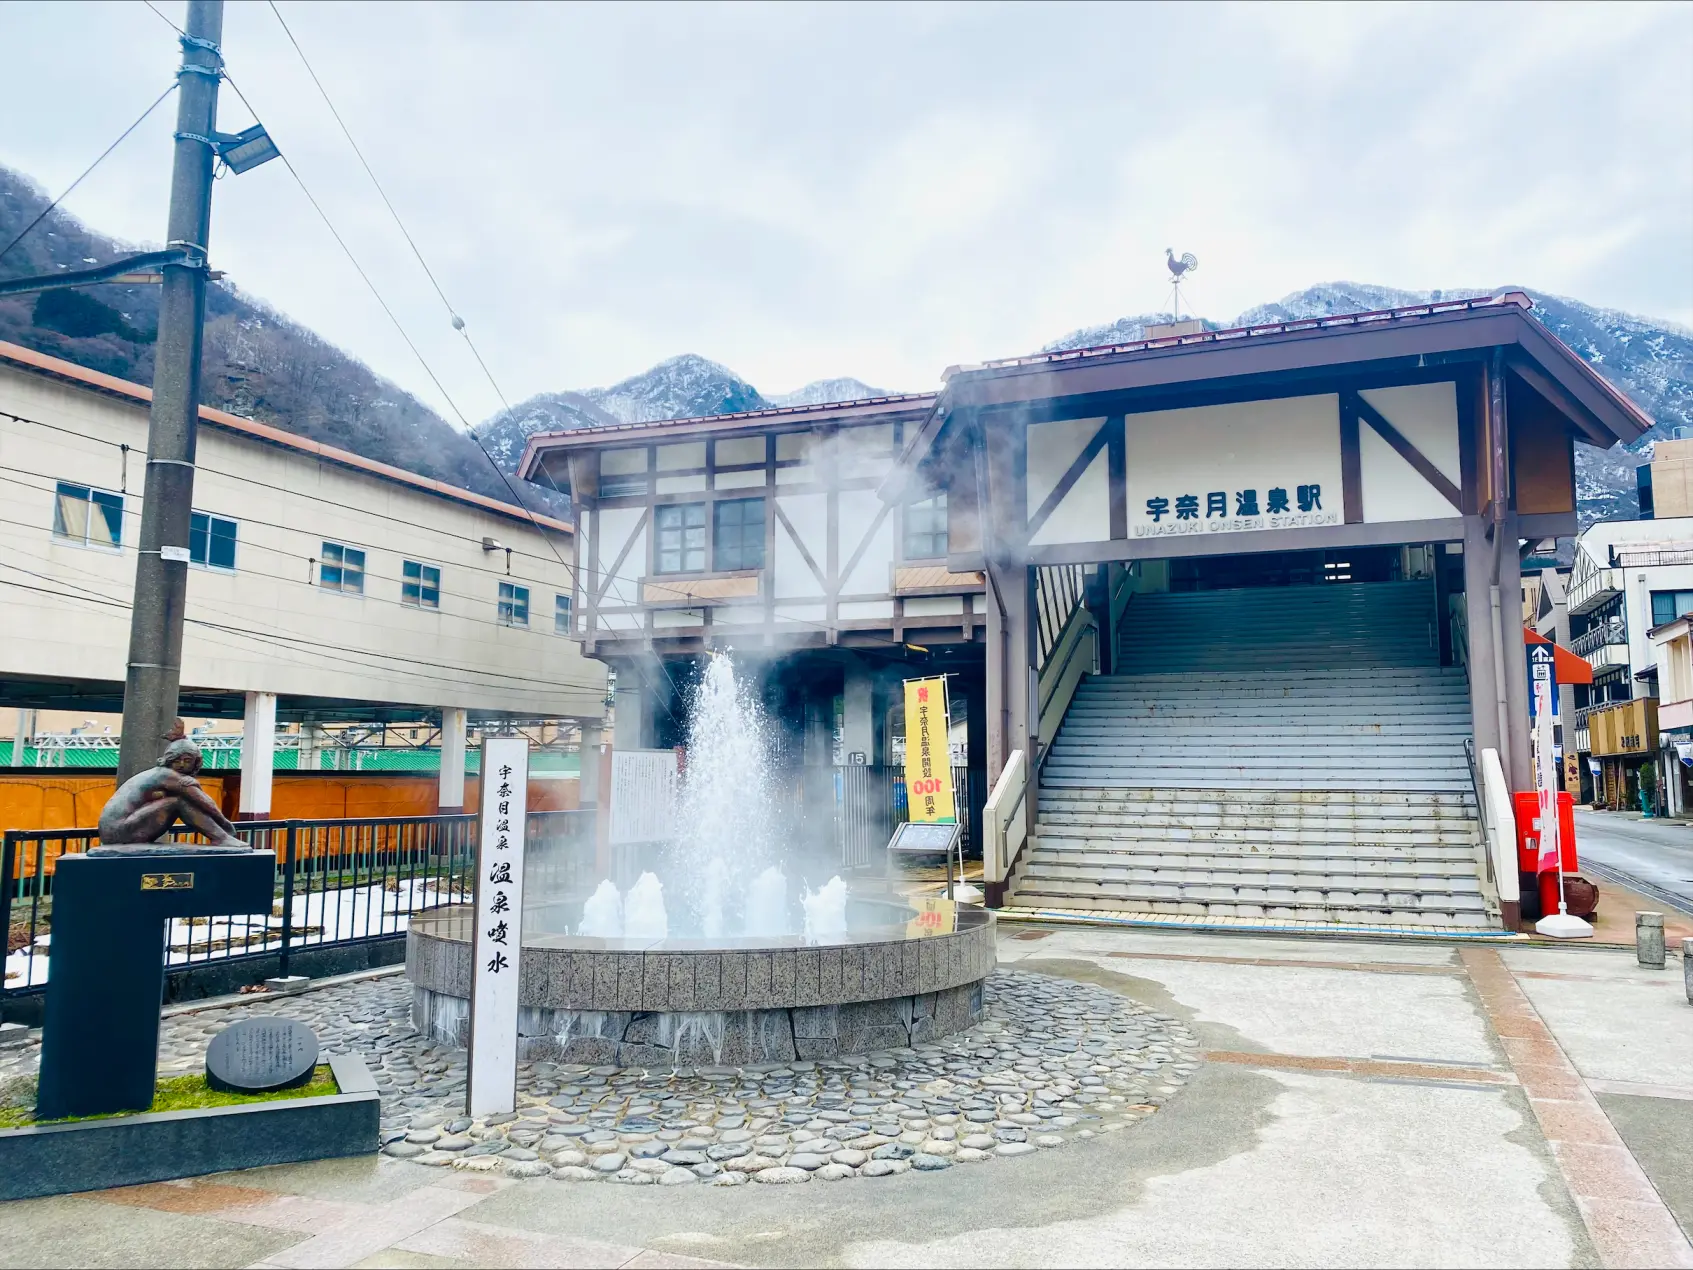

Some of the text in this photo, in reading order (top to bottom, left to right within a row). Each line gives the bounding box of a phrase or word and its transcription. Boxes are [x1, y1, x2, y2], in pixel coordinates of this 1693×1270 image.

[1146, 484, 1322, 523] 宇奈月温泉駅
[1134, 511, 1338, 538] UNAZUKI ONSEN STATION
[851, 753, 865, 765] 15
[487, 862, 514, 974] 温泉噴水
